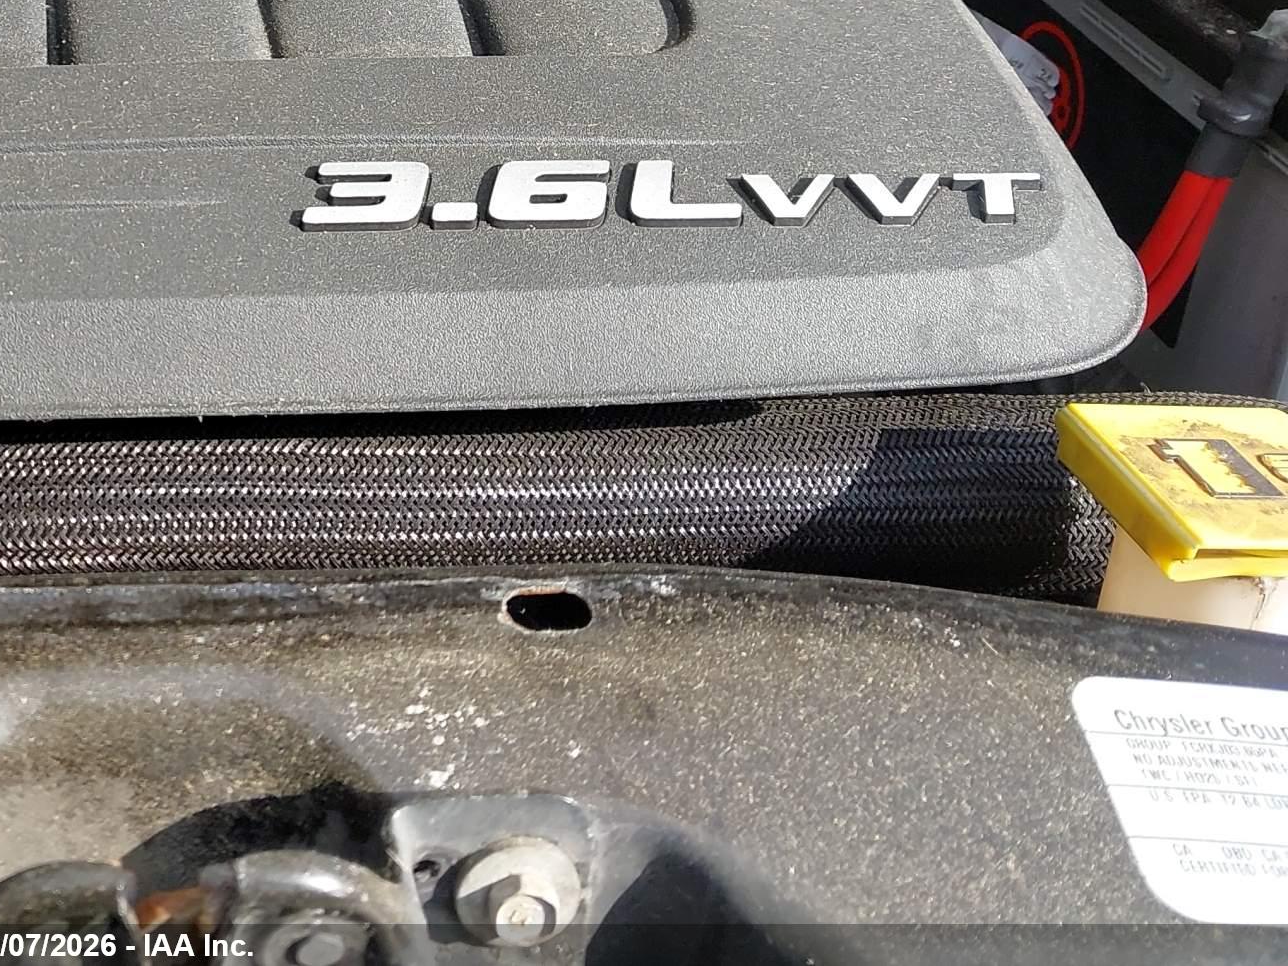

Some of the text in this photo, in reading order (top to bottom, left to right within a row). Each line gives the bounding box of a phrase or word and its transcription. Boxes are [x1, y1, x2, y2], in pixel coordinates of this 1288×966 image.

[294, 160, 1041, 232] 3.6L VVT
[1114, 709, 1213, 737] Chrysler
